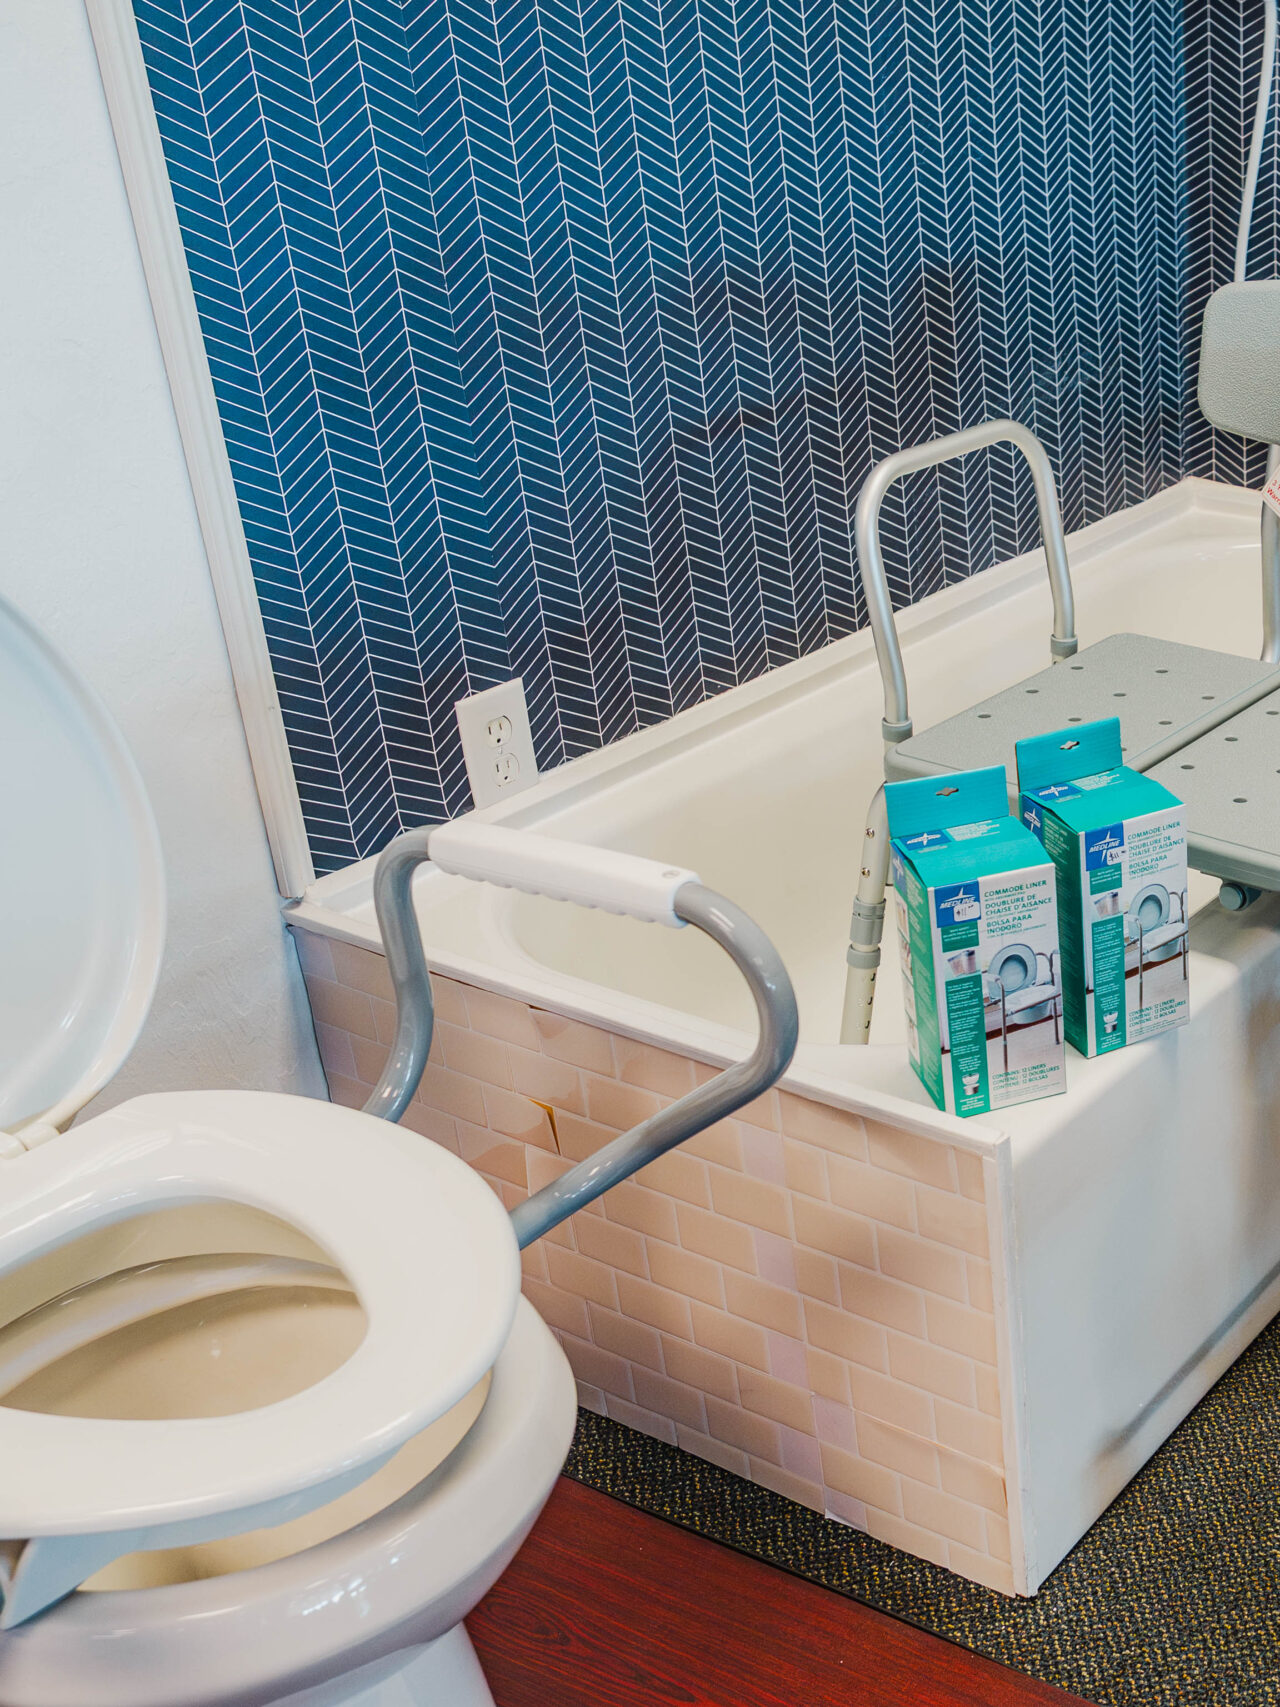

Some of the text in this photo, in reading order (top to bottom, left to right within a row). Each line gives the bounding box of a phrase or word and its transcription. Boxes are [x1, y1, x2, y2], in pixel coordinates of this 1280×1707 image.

[1128, 827, 1161, 840] COMMODE
[1162, 821, 1180, 831] LINER
[1089, 840, 1120, 853] MEDLINE
[1129, 860, 1149, 869] BOLSA
[1150, 854, 1168, 863] PARA
[1129, 864, 1159, 876] INODORO
[984, 885, 1024, 898] COMMODE
[1026, 880, 1047, 889] LINER
[939, 896, 976, 909] MEDLINE
[986, 896, 1024, 909] DOUBLURE
[986, 906, 1011, 916] CHAISE
[1014, 897, 1052, 910] D'AISANCE
[987, 914, 1032, 928] BOLSA PARA
[987, 922, 1022, 934] INODORO
[1028, 1063, 1047, 1072] LINERS
[1028, 1065, 1060, 1077] DOUBLURES
